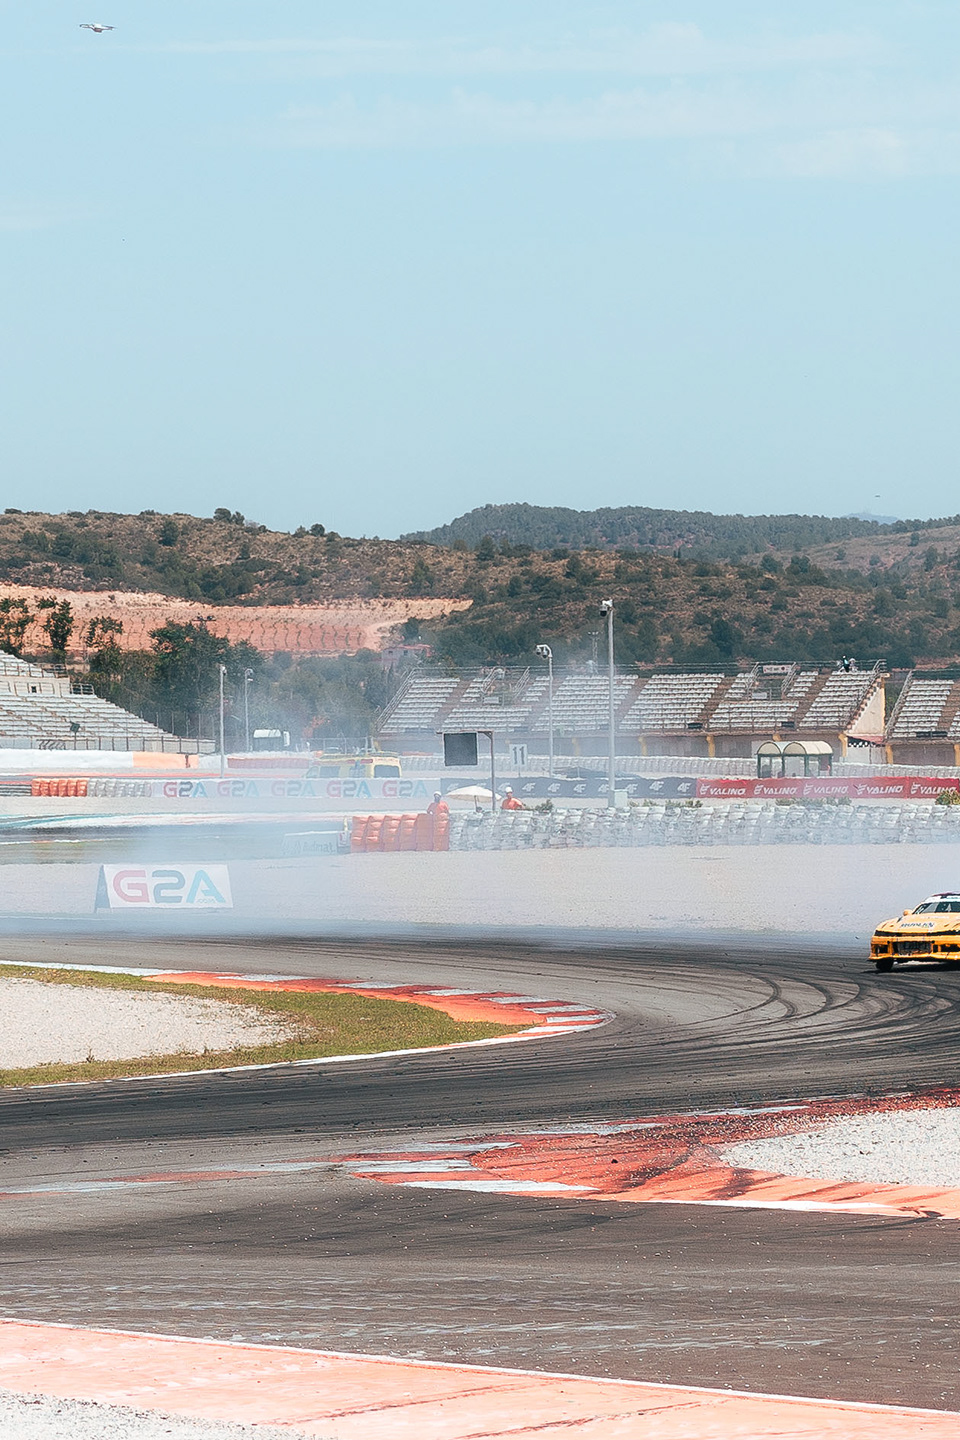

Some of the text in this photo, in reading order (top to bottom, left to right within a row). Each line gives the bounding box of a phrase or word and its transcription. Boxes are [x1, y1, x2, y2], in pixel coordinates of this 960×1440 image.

[512, 746, 525, 765] 11
[163, 780, 428, 798] G2A G2A G2A G2A G2A
[710, 787, 746, 796] VALINO
[763, 786, 797, 795] VALINO
[813, 786, 848, 794] VALINO
[867, 785, 903, 794] VALINO
[112, 869, 226, 904] G2A
